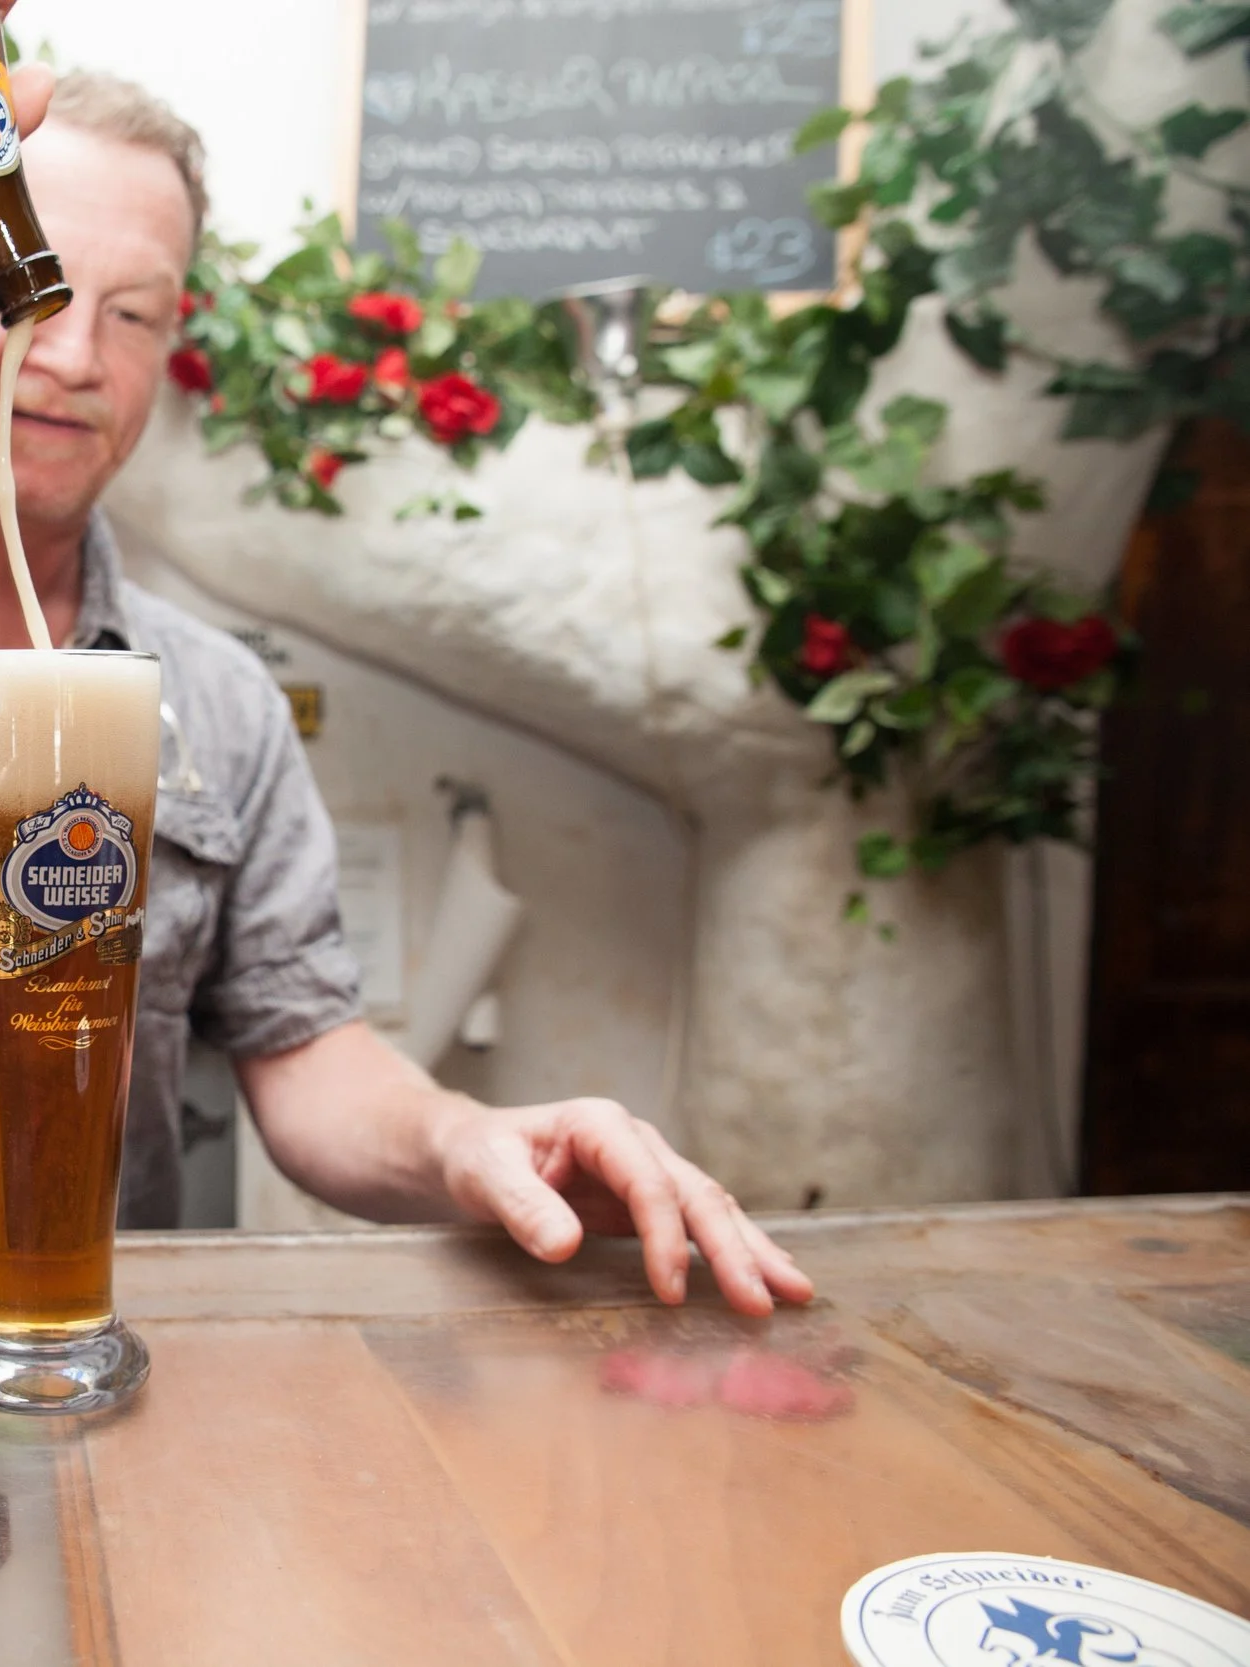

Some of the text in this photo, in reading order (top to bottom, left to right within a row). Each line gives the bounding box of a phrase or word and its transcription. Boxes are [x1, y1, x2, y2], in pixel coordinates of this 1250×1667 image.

[28, 865, 123, 885] SCHNEIDER
[44, 886, 110, 906] WEISSE
[76, 926, 84, 940] &
[89, 911, 123, 937] Sohn
[24, 974, 112, 992] Braukunst
[46, 994, 84, 1018] für
[10, 1013, 119, 1032] Weissbierkenner
[919, 1566, 1092, 1591] Schneider
